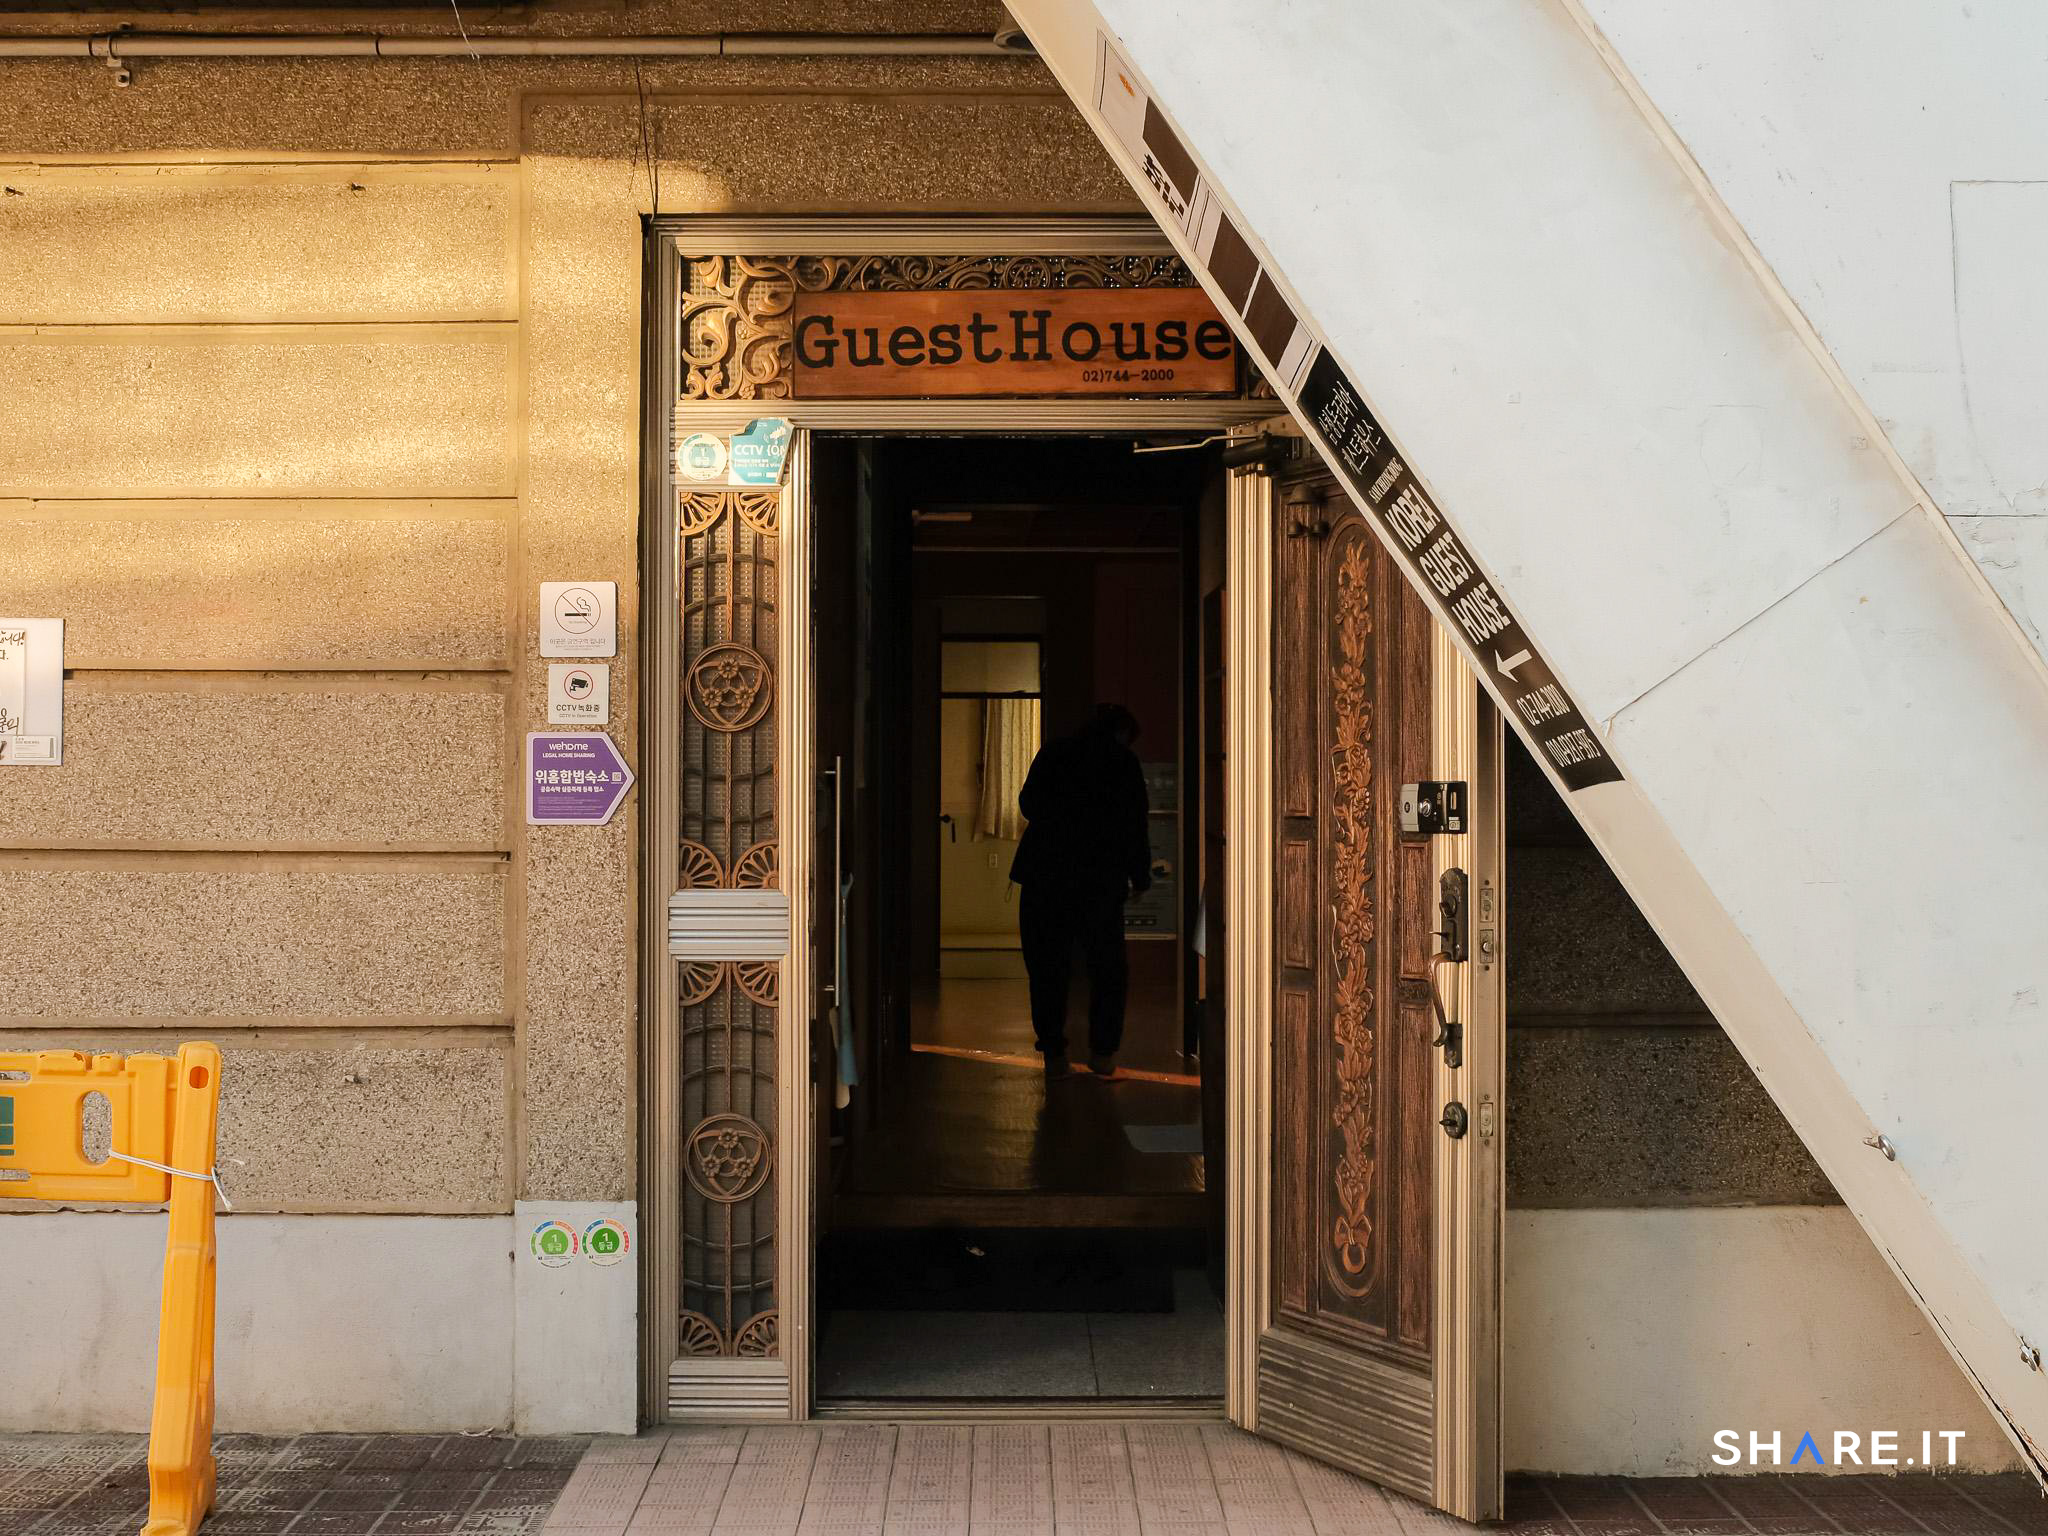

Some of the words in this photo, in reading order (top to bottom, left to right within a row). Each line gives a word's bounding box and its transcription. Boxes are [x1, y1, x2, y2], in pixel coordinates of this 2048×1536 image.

[734, 444, 764, 456] CCTV
[1384, 483, 1441, 552] KOREA
[1419, 531, 1475, 597] GUEST
[1451, 582, 1511, 645] HOUSE
[556, 704, 577, 712] CCTV
[1516, 683, 1571, 727] 02-744-2000
[534, 769, 610, 785] 위홈합법숙소
[602, 1232, 609, 1242] 1
